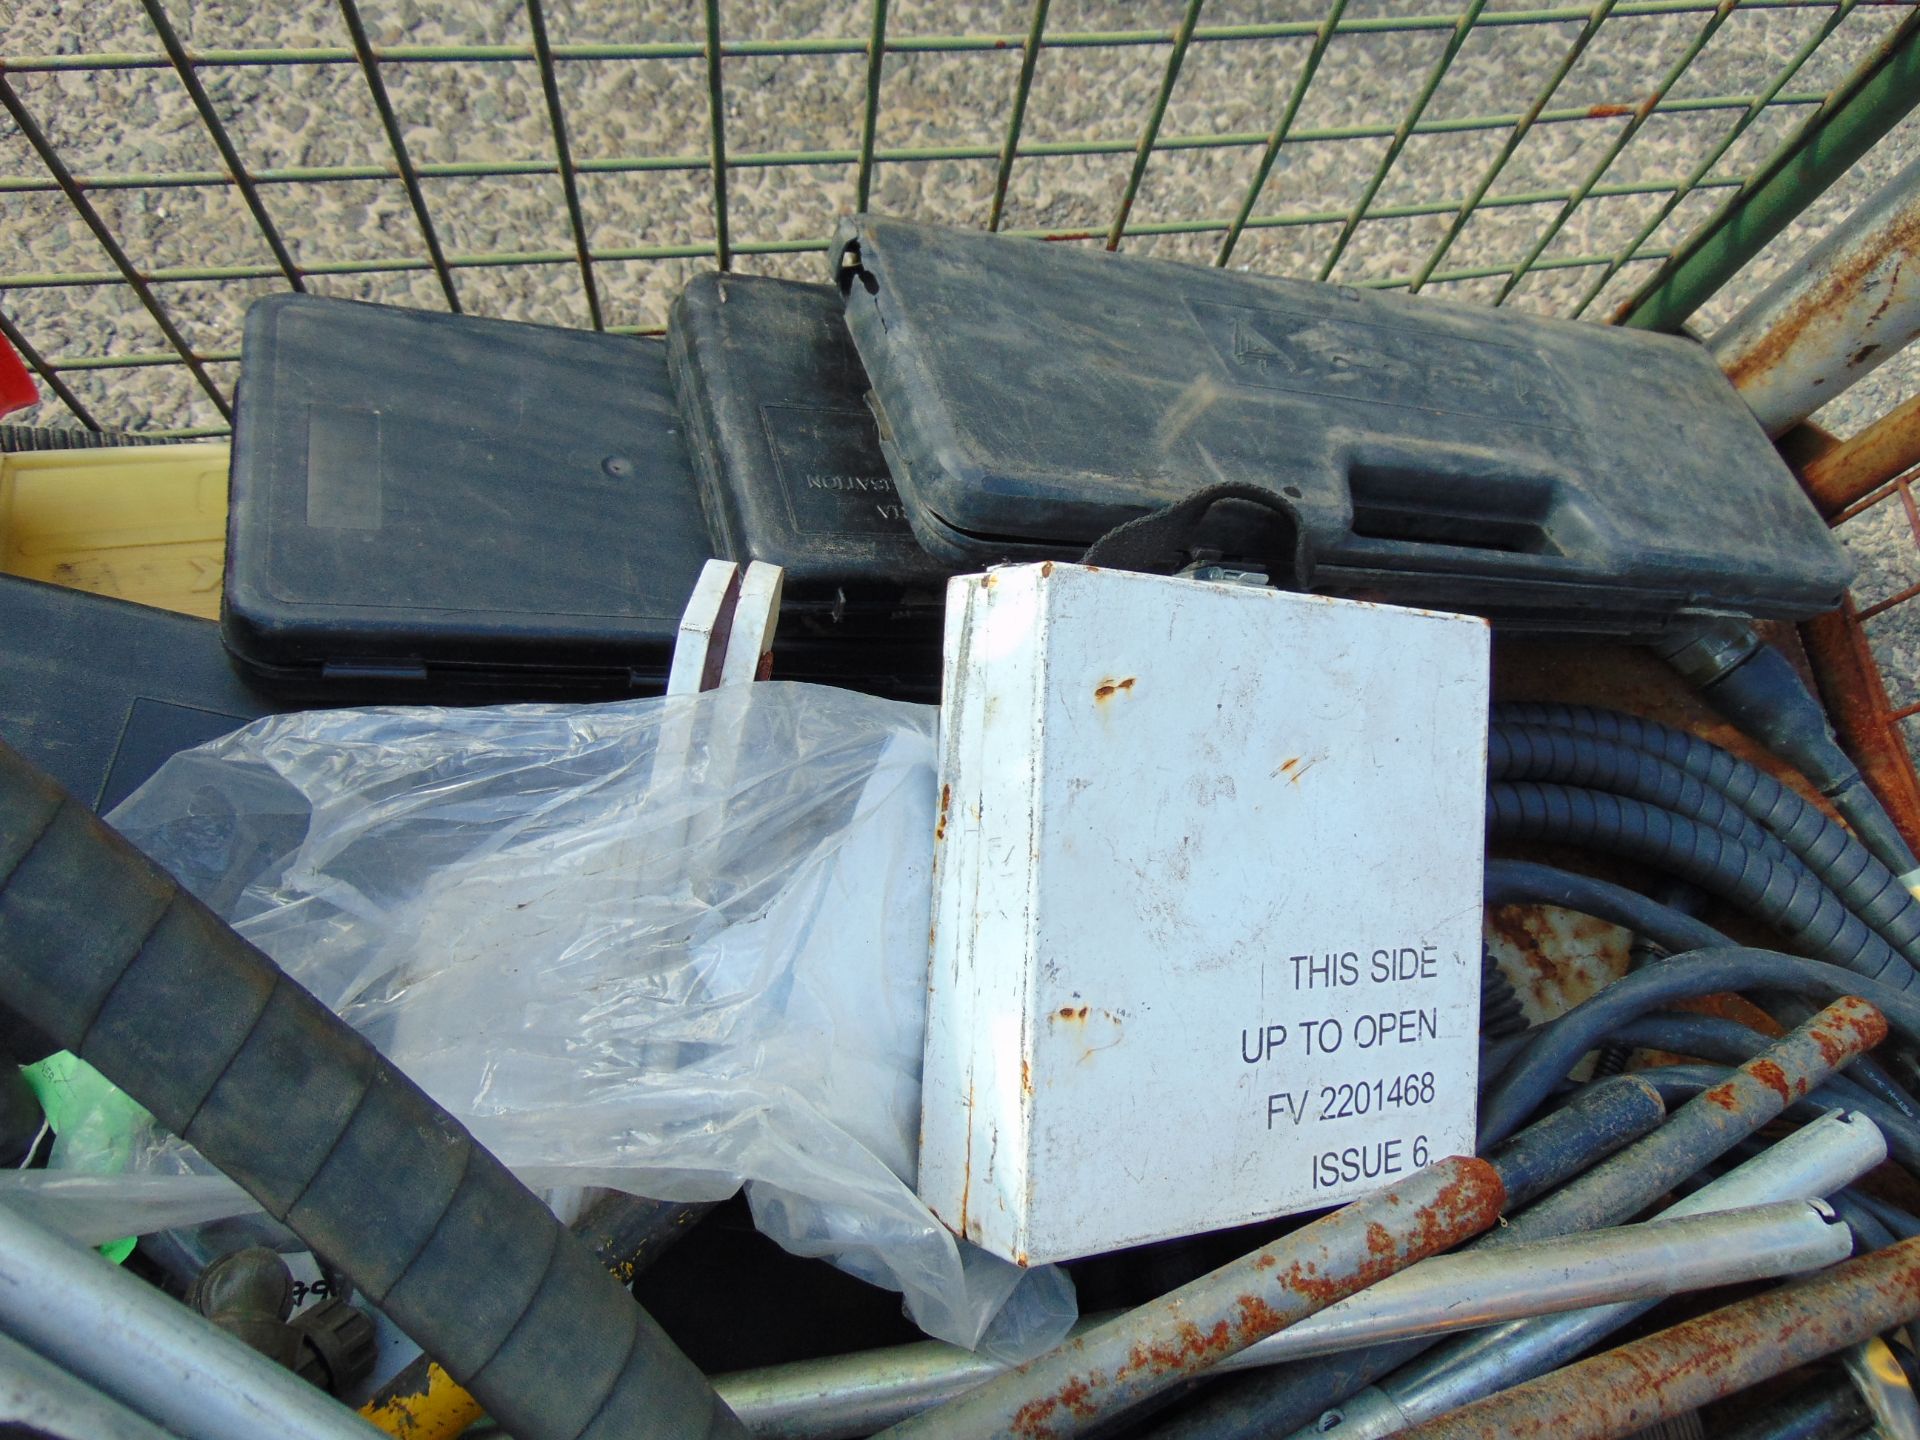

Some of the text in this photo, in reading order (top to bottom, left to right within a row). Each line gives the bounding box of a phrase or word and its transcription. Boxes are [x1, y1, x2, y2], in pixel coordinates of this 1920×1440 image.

[1289, 946, 1438, 990] THIS SIDE
[1241, 1007, 1438, 1064] UP TO OPEN
[1267, 1071, 1436, 1130] FV 2201468
[1313, 1139, 1403, 1190] ISSUE
